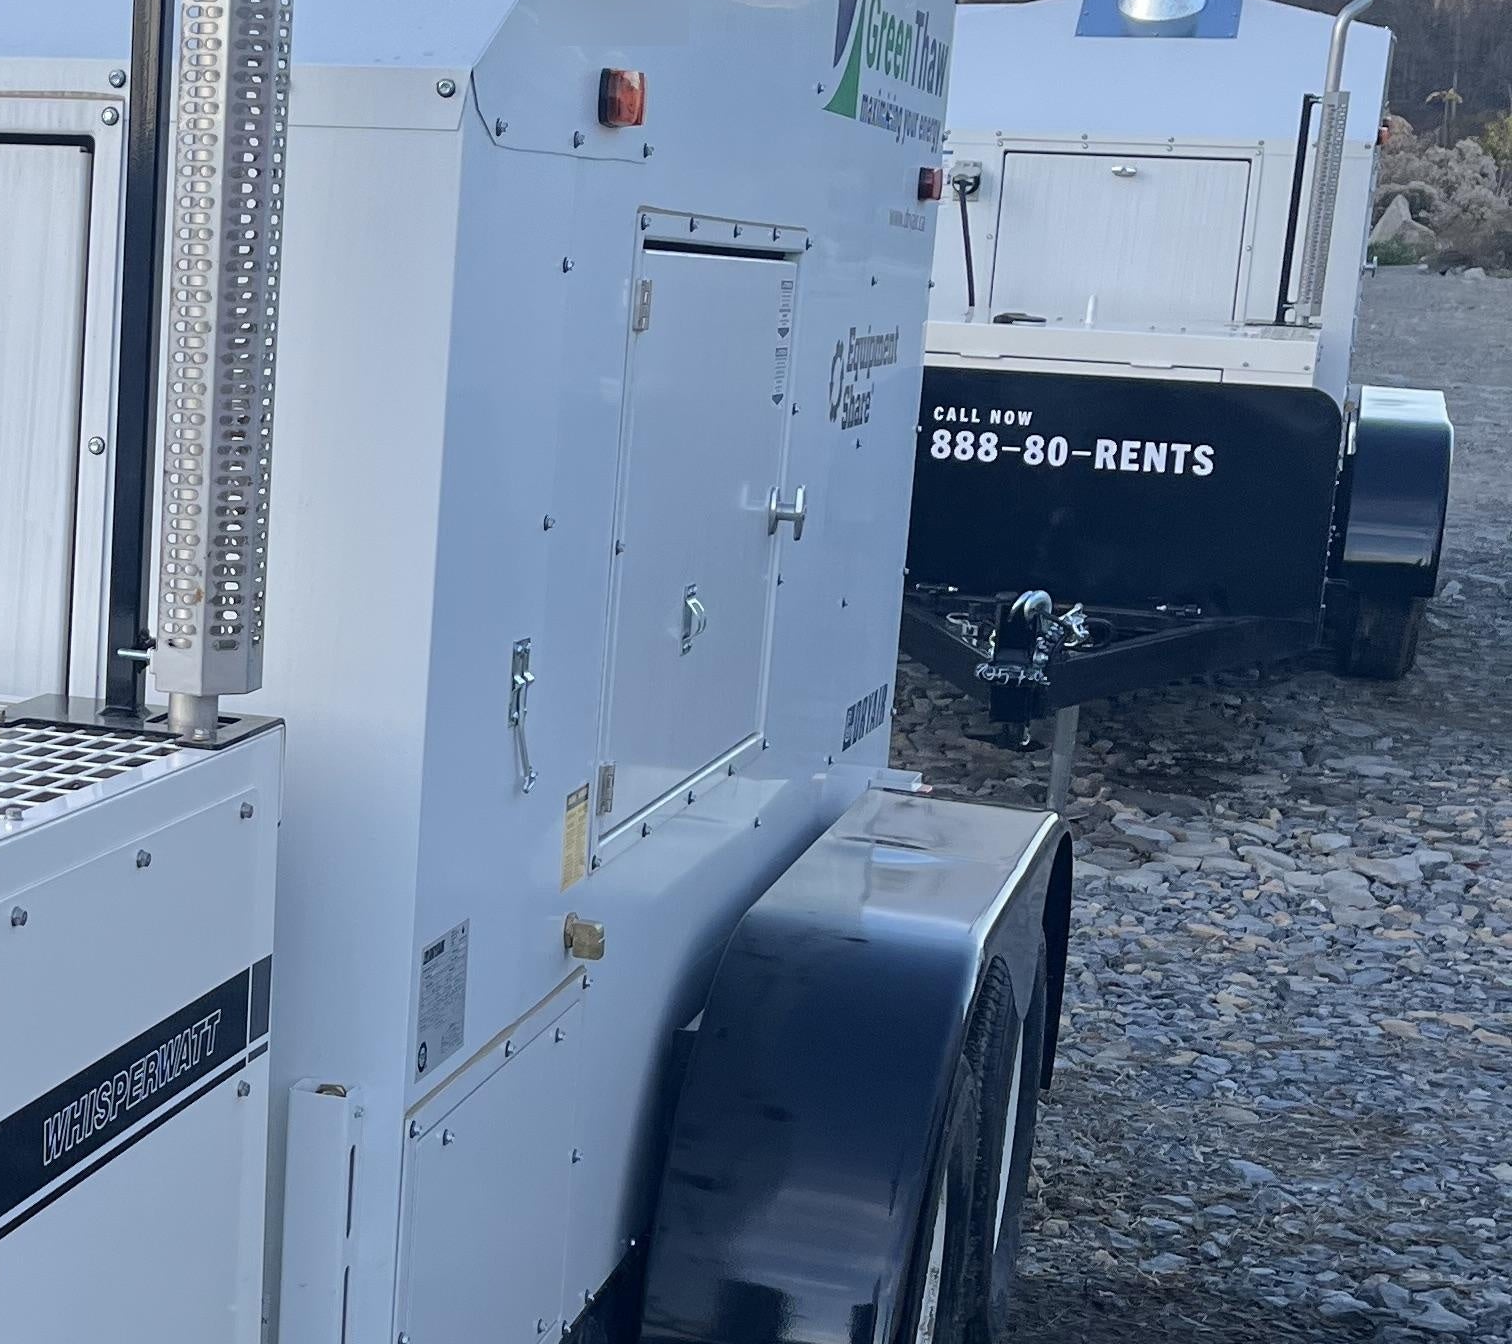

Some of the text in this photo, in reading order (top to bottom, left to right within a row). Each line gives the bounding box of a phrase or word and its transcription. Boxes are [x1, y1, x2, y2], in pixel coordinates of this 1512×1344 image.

[846, 325, 899, 382] Equipment
[933, 406, 1033, 427] CALL NOW
[930, 428, 1215, 477] 888-80-RENTS
[43, 1008, 222, 1167] WHISPERWATT
